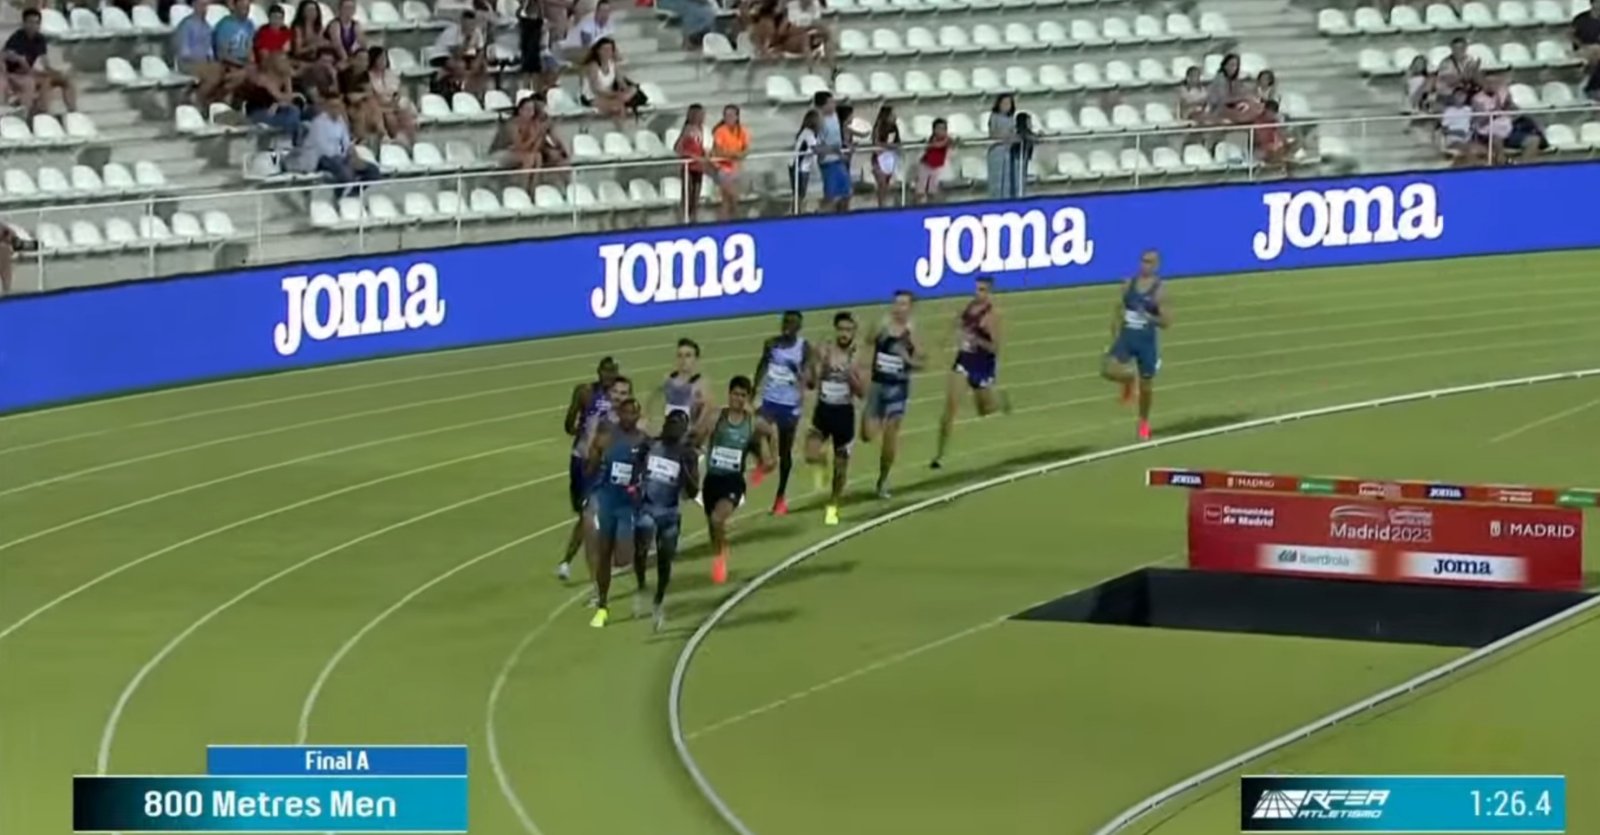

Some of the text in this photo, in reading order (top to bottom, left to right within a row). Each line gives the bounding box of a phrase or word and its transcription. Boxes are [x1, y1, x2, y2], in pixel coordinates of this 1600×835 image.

[1238, 479, 1275, 488] MADRID
[1223, 505, 1275, 517] Comunidad
[1223, 515, 1274, 527] de Madrid
[1330, 522, 1432, 543] Madrid2023
[1510, 523, 1576, 538] MADRID
